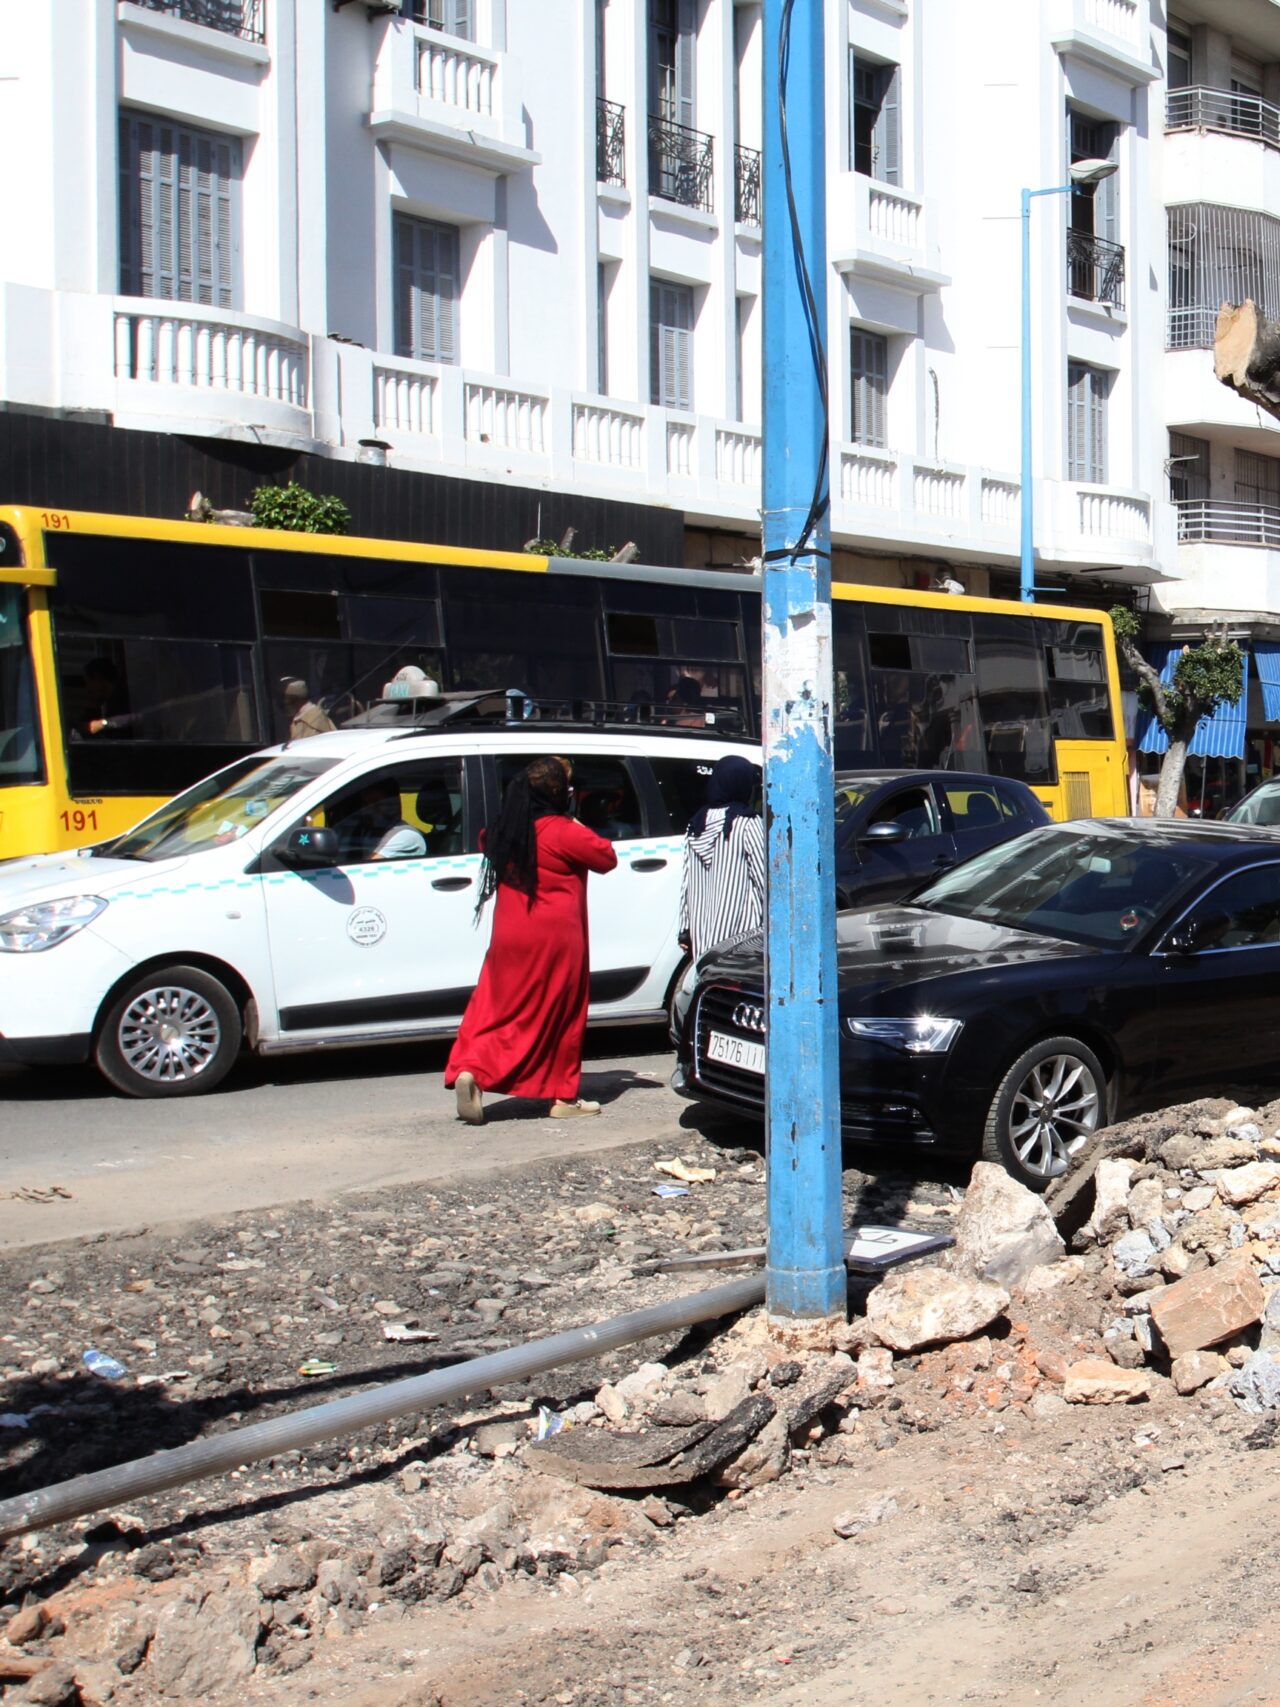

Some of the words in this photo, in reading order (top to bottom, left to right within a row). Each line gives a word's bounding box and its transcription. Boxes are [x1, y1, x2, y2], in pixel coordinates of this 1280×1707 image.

[41, 513, 70, 530] 191
[60, 810, 98, 832] 191
[712, 1035, 743, 1063] 75176
